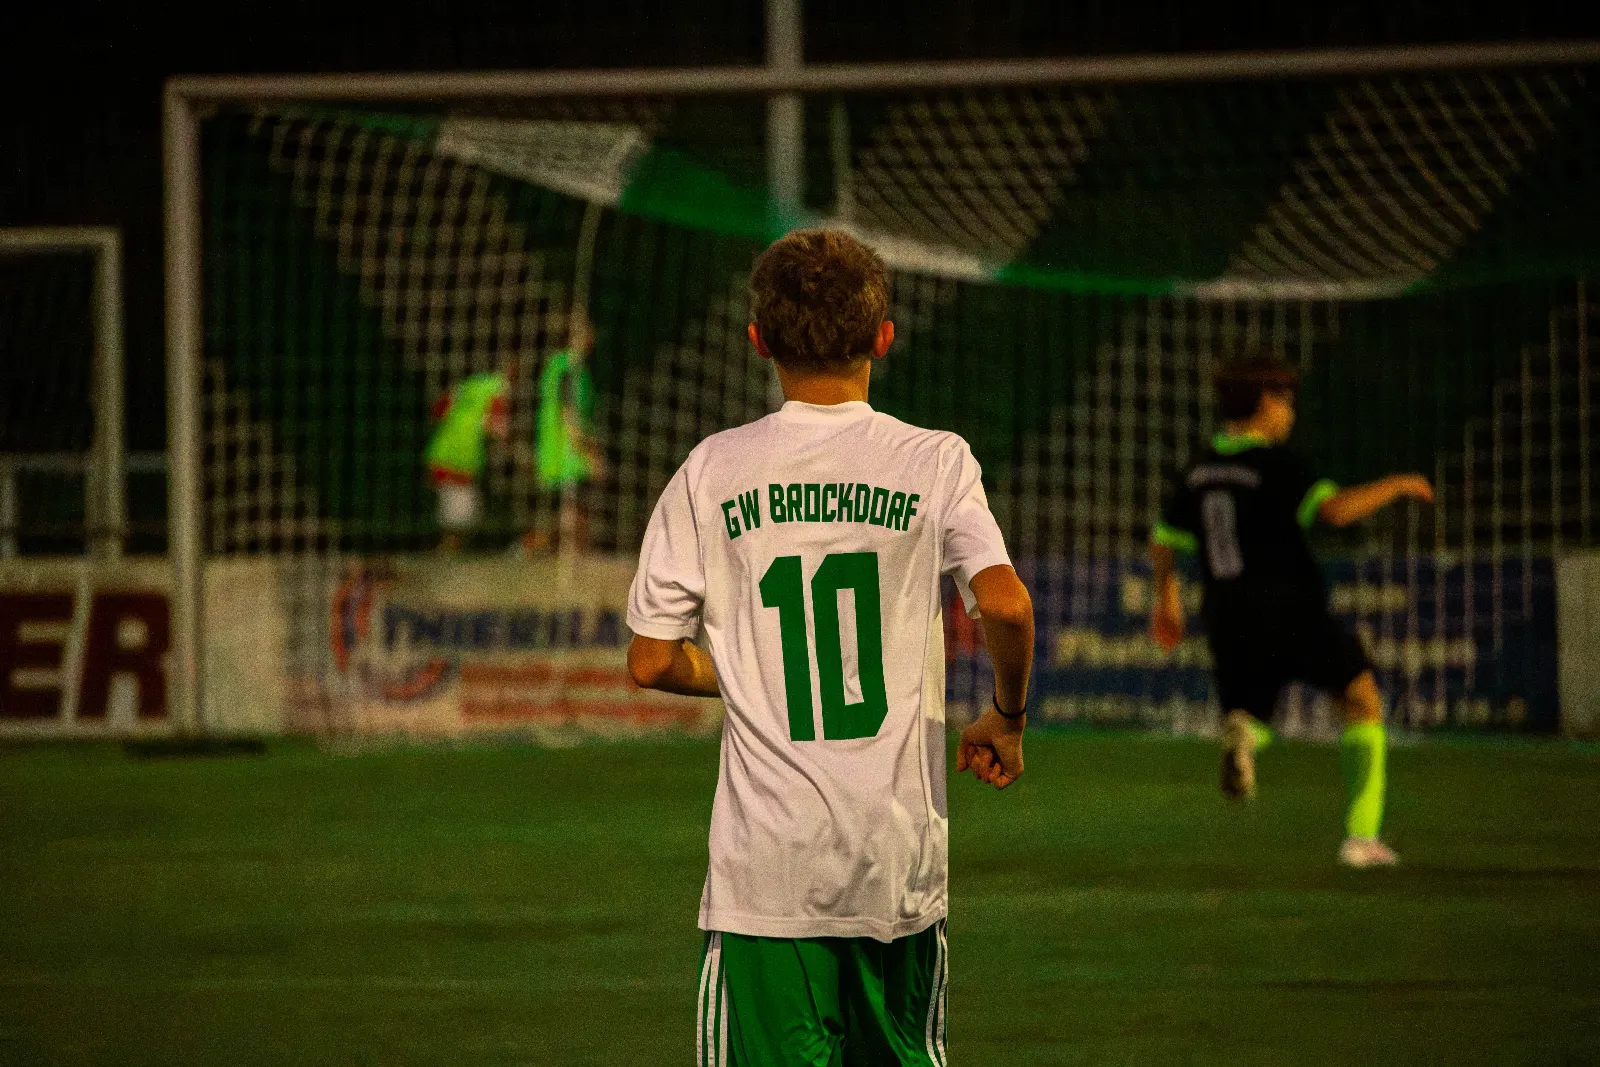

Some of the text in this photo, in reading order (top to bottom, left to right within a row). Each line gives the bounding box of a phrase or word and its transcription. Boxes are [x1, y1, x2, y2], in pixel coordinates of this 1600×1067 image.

[721, 483, 920, 540] GW BROCKDORF
[0, 591, 170, 719] ER
[759, 552, 889, 742] 10
